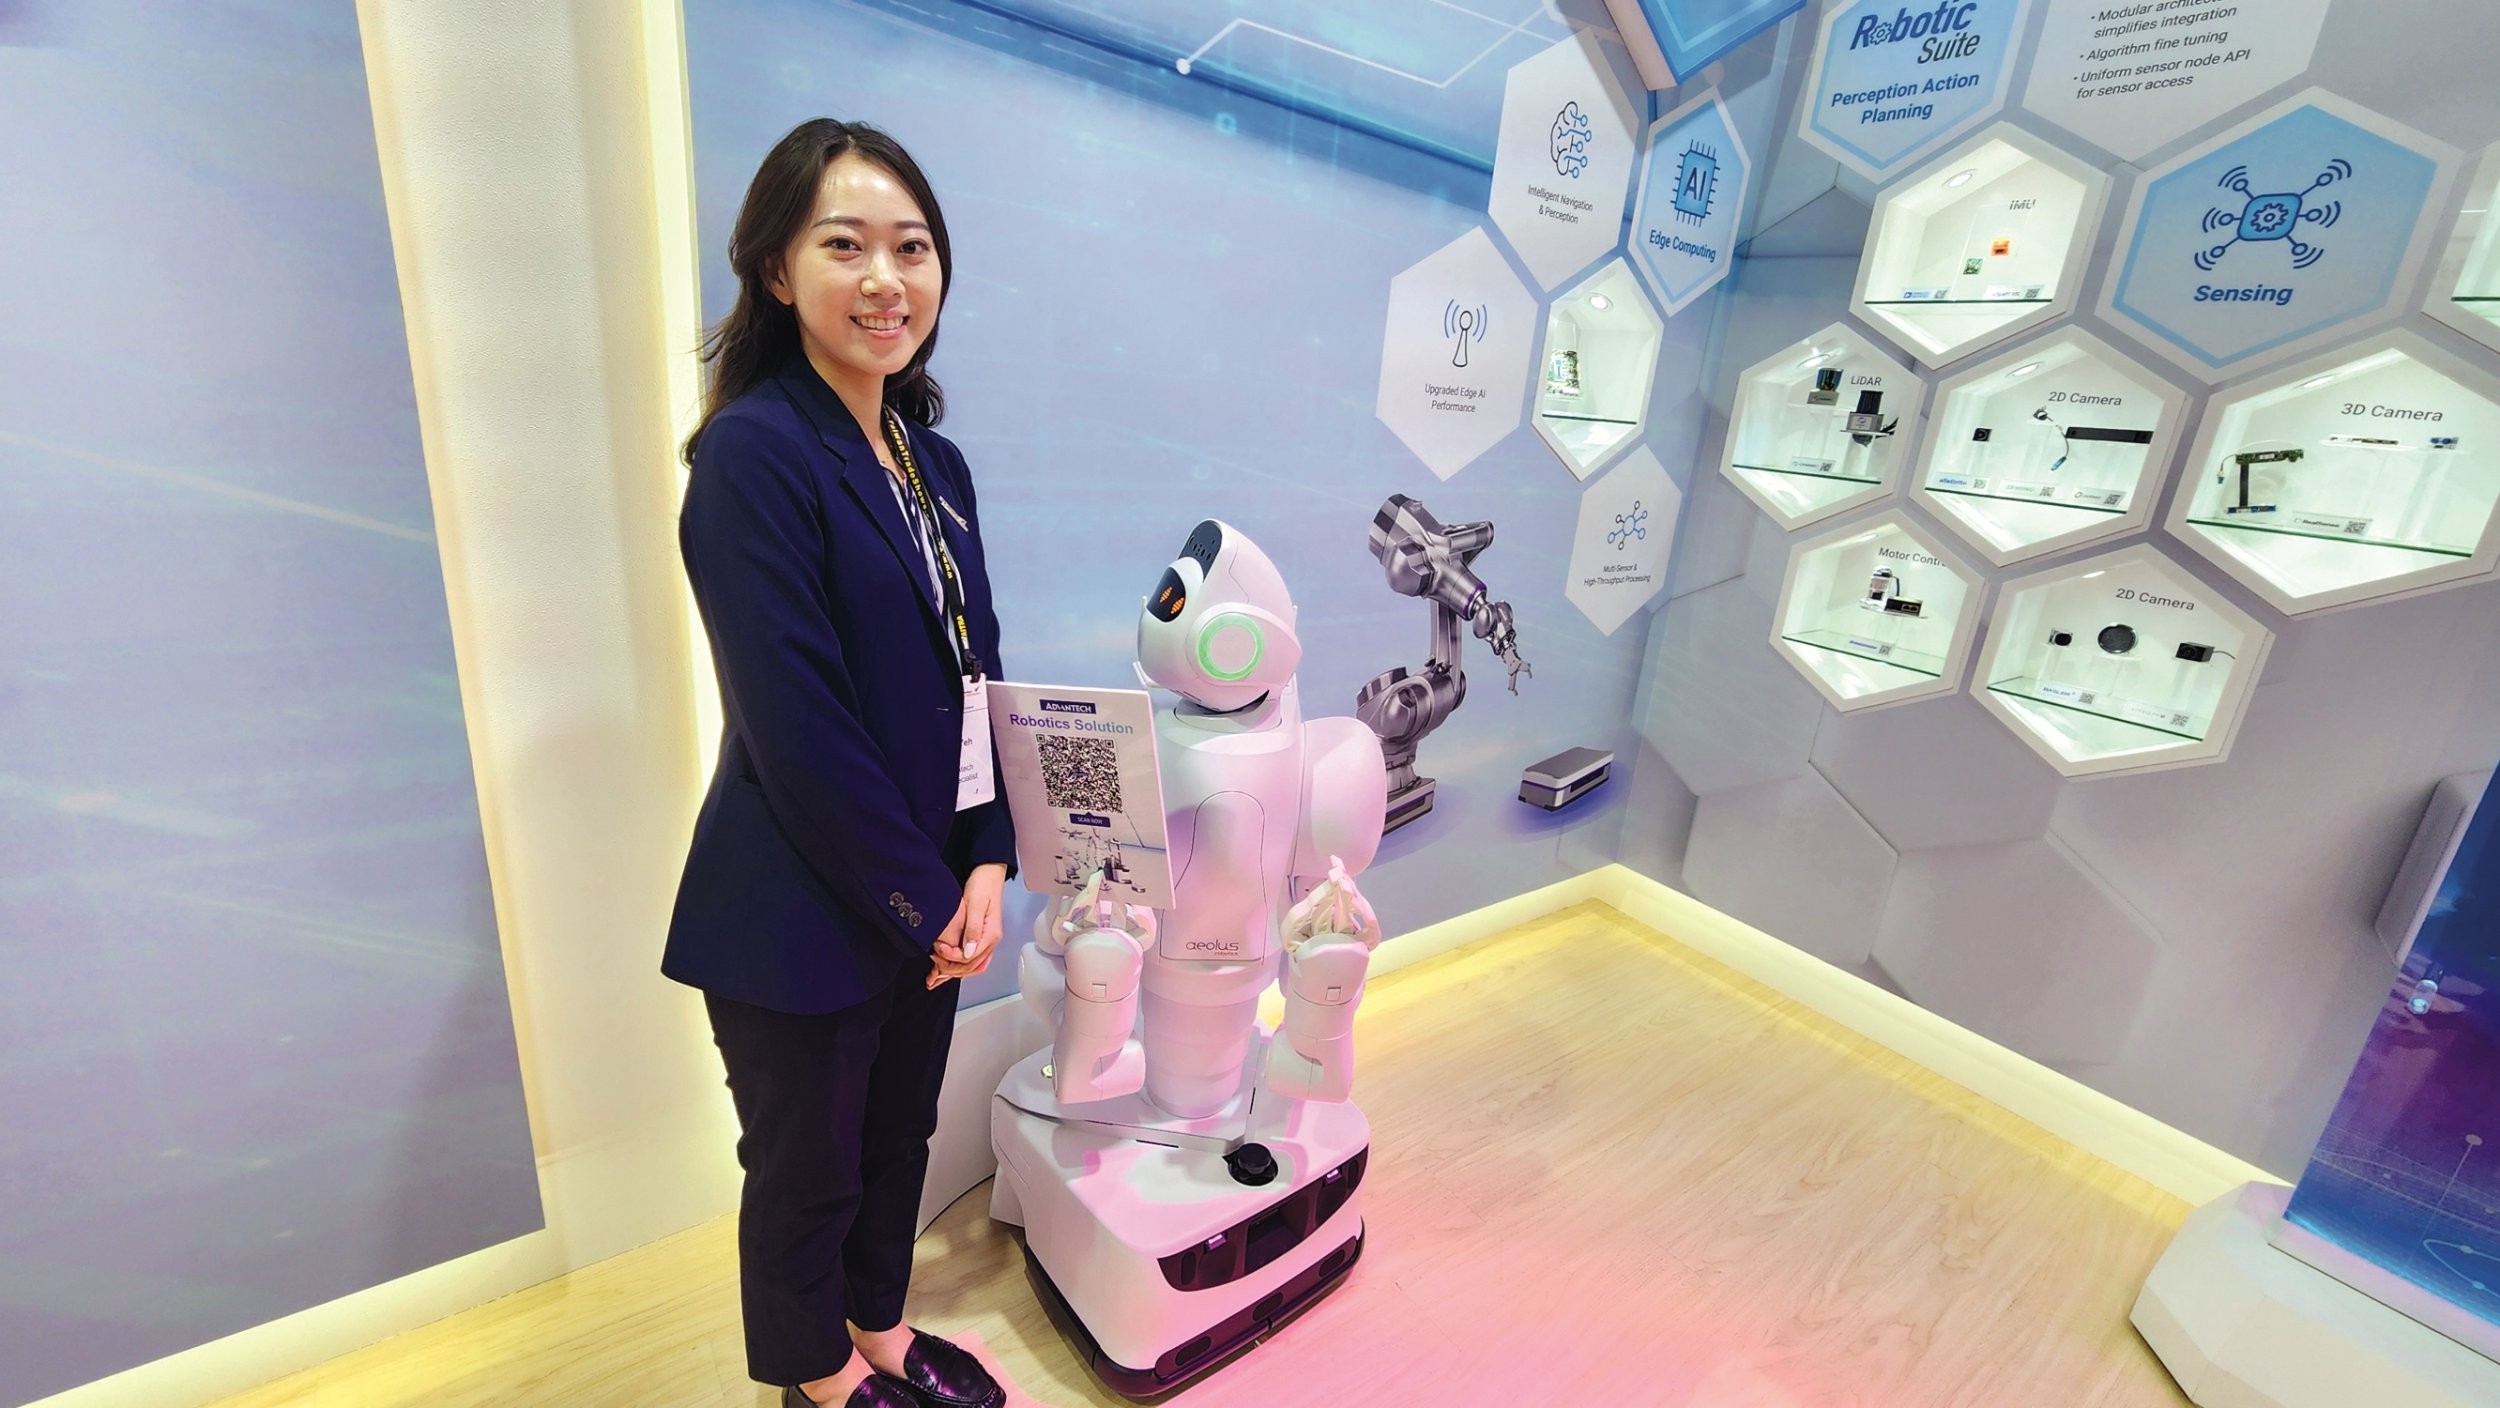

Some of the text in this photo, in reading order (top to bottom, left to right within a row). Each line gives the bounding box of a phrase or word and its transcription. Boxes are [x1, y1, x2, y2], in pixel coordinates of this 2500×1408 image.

[2094, 6, 2238, 39] simplifies integration
[2098, 4, 2153, 23] Modular
[1917, 32, 1980, 64] Suite
[2086, 30, 2228, 61] Algorithm fine tuning
[2080, 49, 2251, 83] Uniform sensor node API
[1831, 73, 1980, 107] Perception Action
[2076, 75, 2194, 99] for sensor access
[1861, 103, 1934, 125] Planning
[1683, 167, 1707, 201] AI
[1528, 184, 1593, 212] Intelligent Navigation
[1538, 204, 1579, 224] & Perception
[1649, 229, 1717, 263] Edge Computing
[2194, 284, 2293, 306] Sensing
[1425, 383, 1459, 396] Upgraded
[1460, 387, 1477, 399] Edge
[1851, 375, 1882, 387] LiDAR
[1431, 400, 1476, 412] Performance
[2048, 391, 2122, 406] 2D Camera
[2340, 403, 2443, 422] 3D Camera
[1878, 547, 1910, 561] Motor
[2116, 588, 2195, 611] 2D Camera
[1045, 702, 1092, 713] ADVANTECH
[1010, 714, 1134, 735] Robotics Solution
[1186, 939, 1239, 951] aeolus
